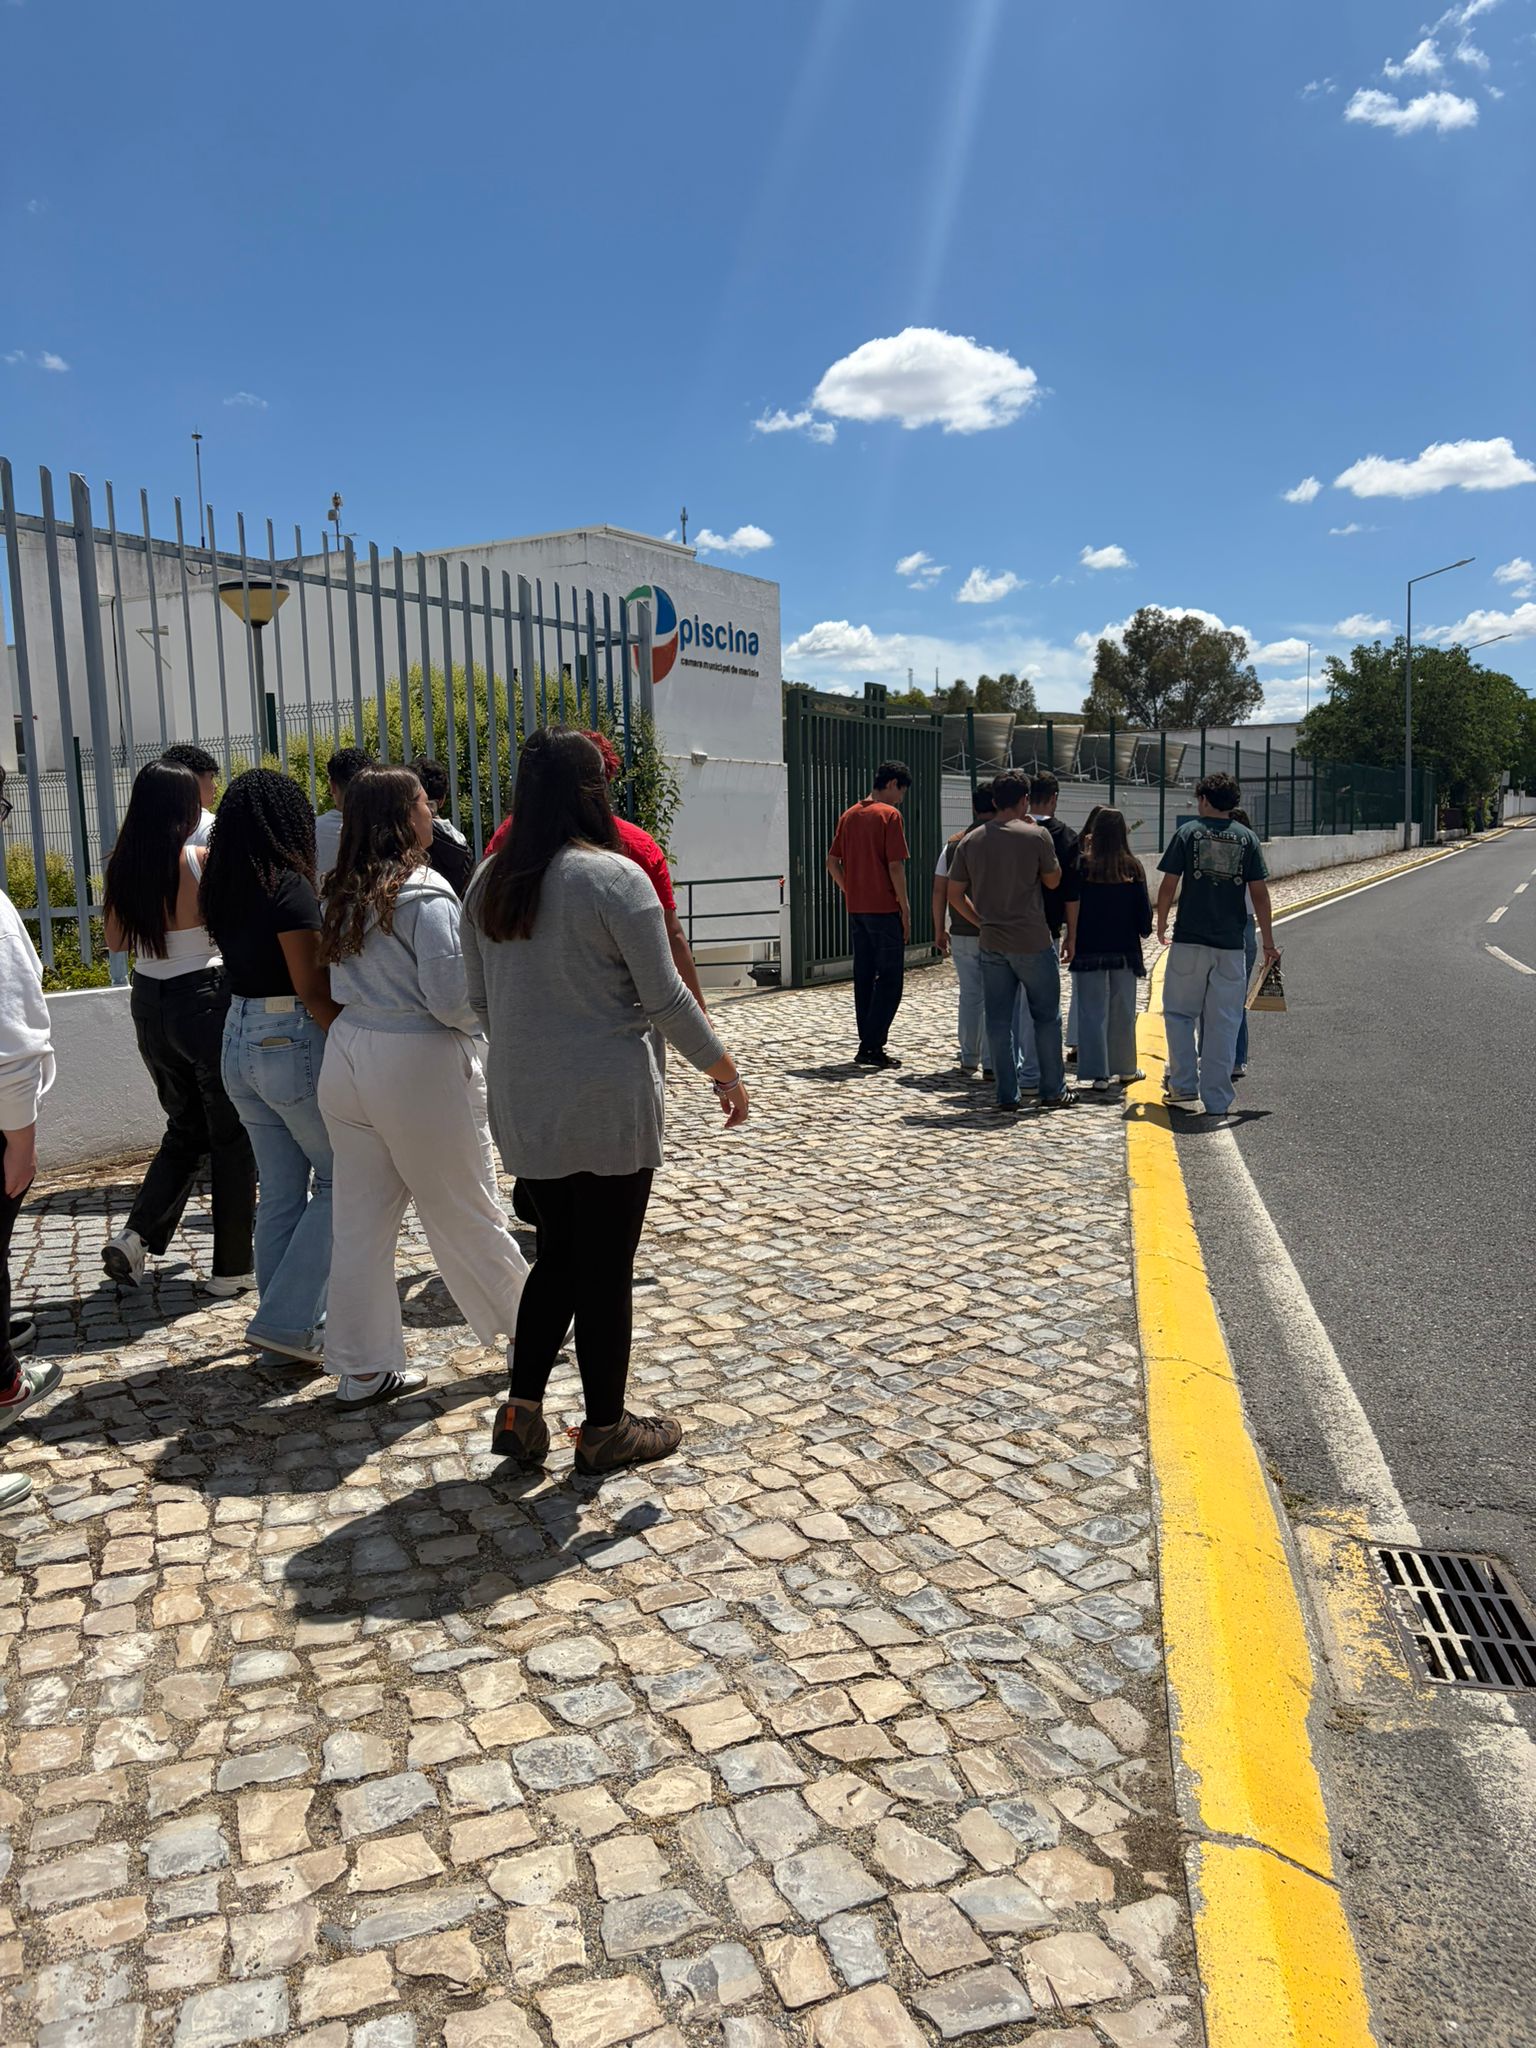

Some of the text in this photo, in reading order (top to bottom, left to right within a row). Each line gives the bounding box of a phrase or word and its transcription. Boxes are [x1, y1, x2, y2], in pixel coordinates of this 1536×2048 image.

[680, 614, 759, 656] piscina
[703, 661, 730, 674] municipal
[731, 664, 738, 674] de
